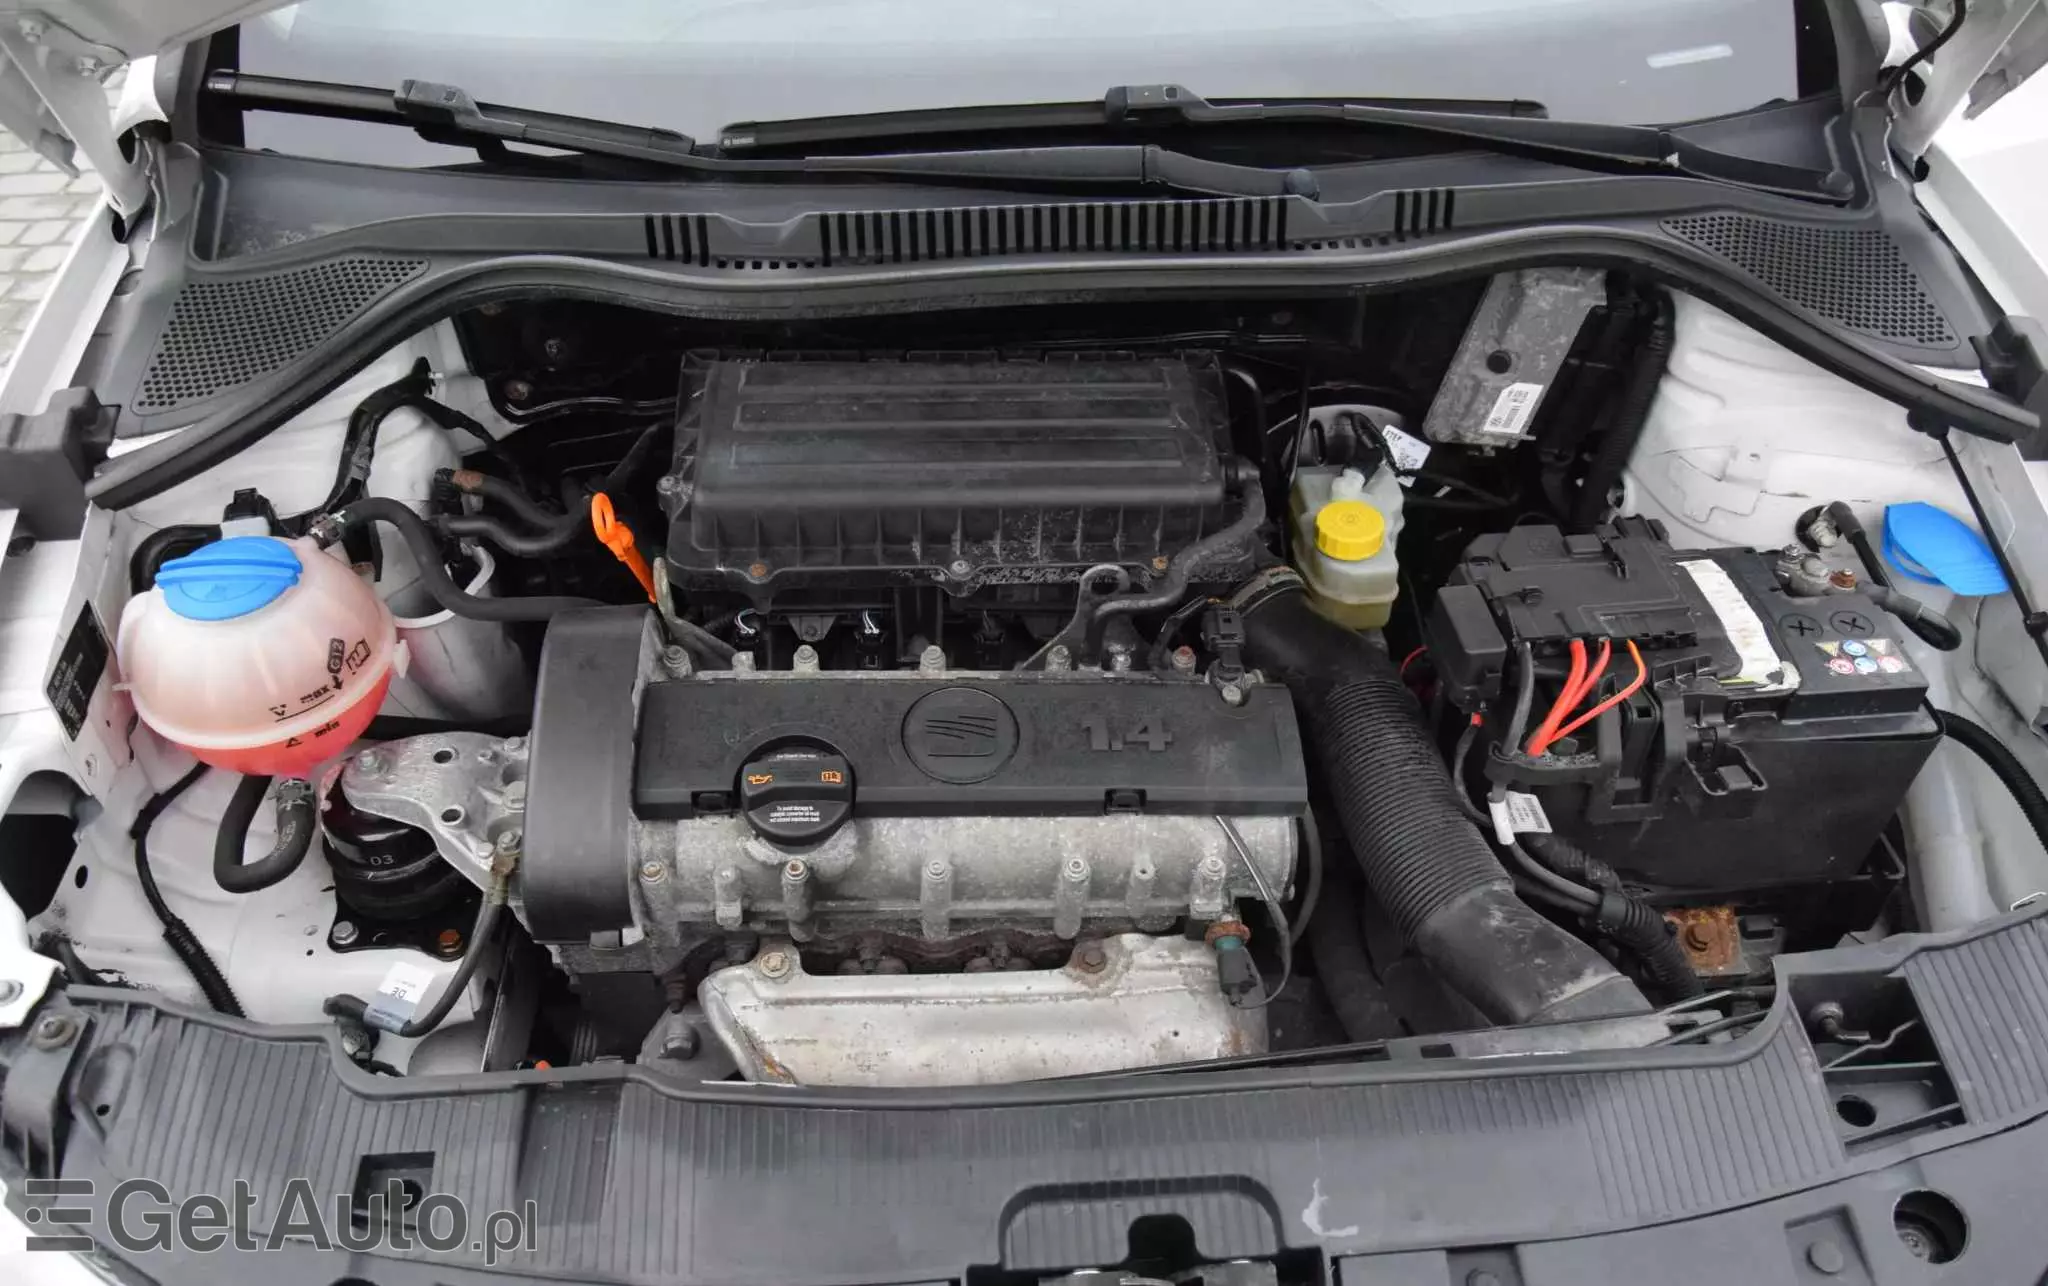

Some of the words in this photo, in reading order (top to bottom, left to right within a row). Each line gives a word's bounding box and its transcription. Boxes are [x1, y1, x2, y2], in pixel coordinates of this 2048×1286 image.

[314, 720, 340, 737] min
[1080, 717, 1173, 752] 1.4
[370, 854, 394, 866] 03
